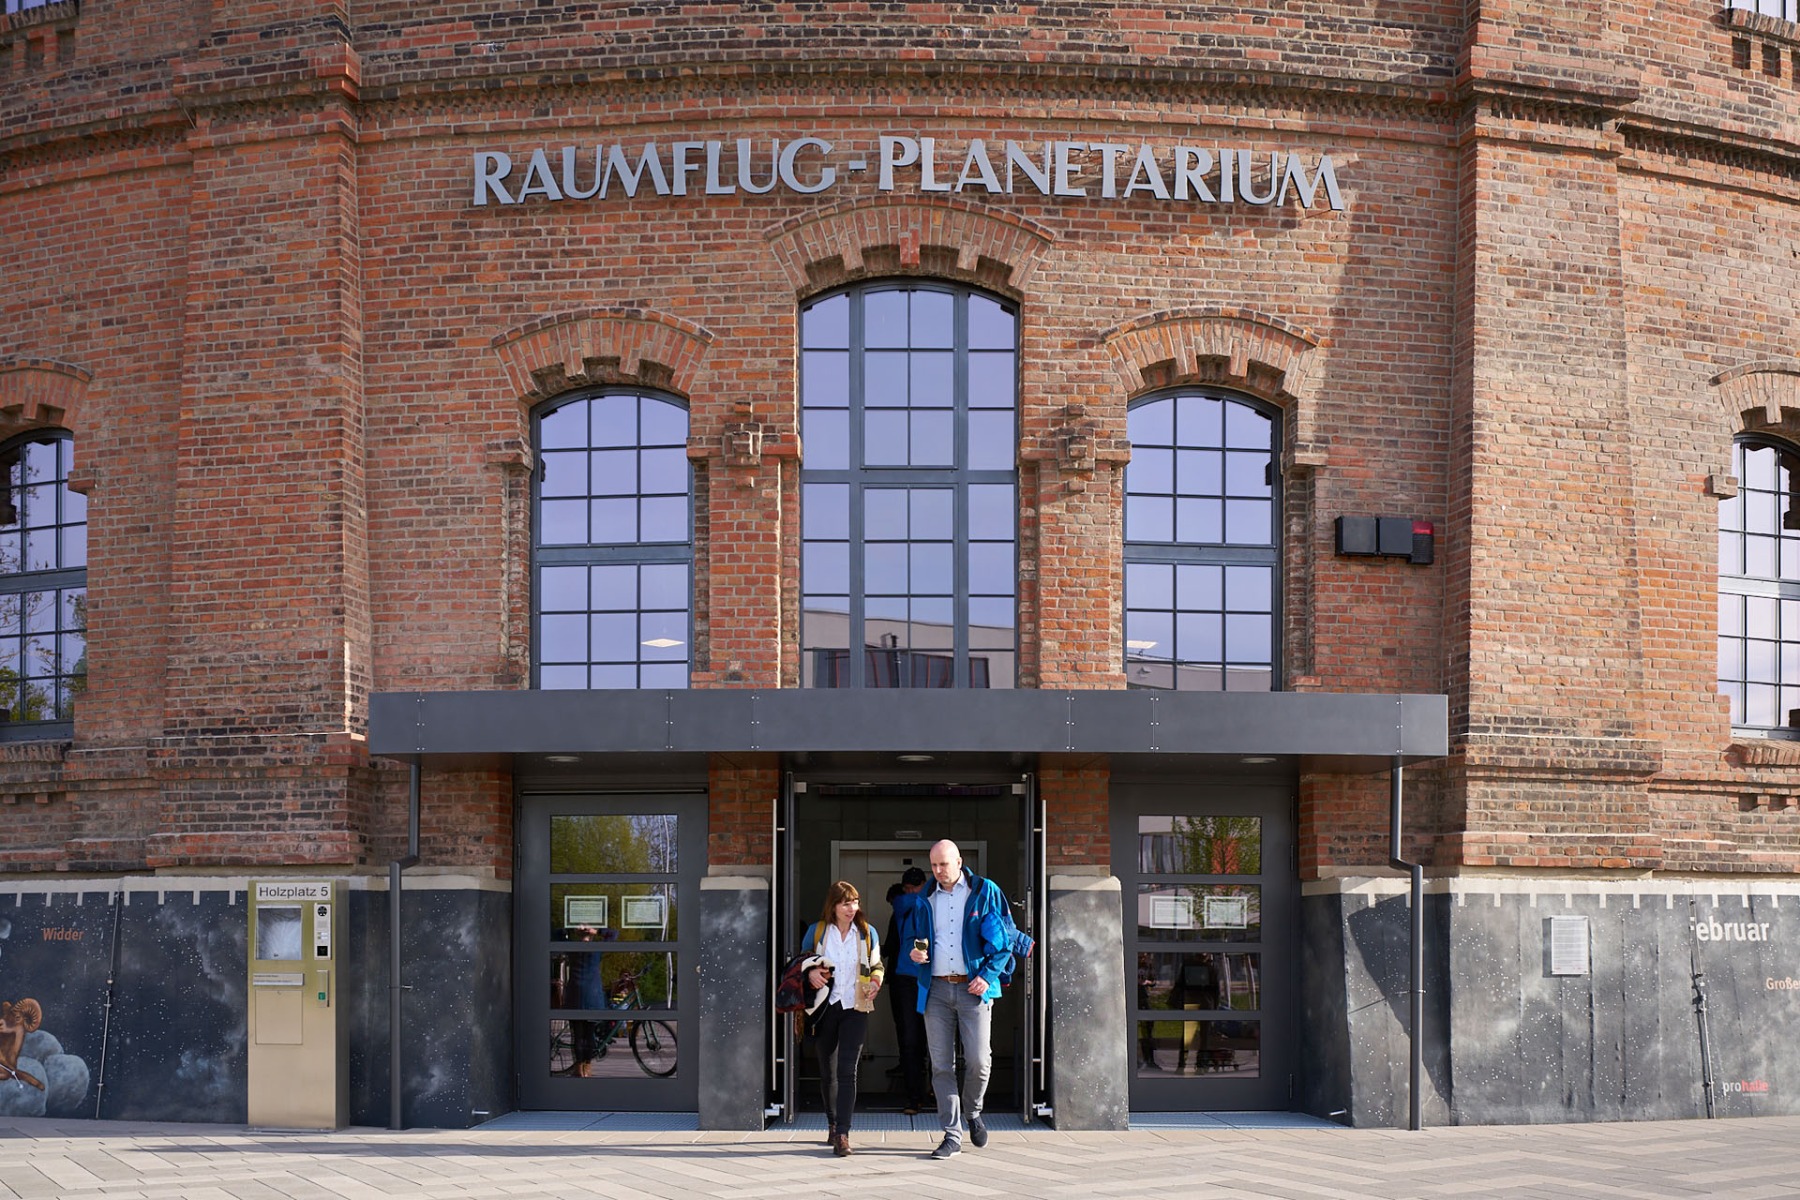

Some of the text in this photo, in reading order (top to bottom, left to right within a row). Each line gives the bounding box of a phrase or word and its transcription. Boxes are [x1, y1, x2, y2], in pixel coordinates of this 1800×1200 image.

[259, 886, 328, 899] Holzplatz 5
[42, 927, 85, 941] Widder
[1689, 916, 1769, 942] ebruar
